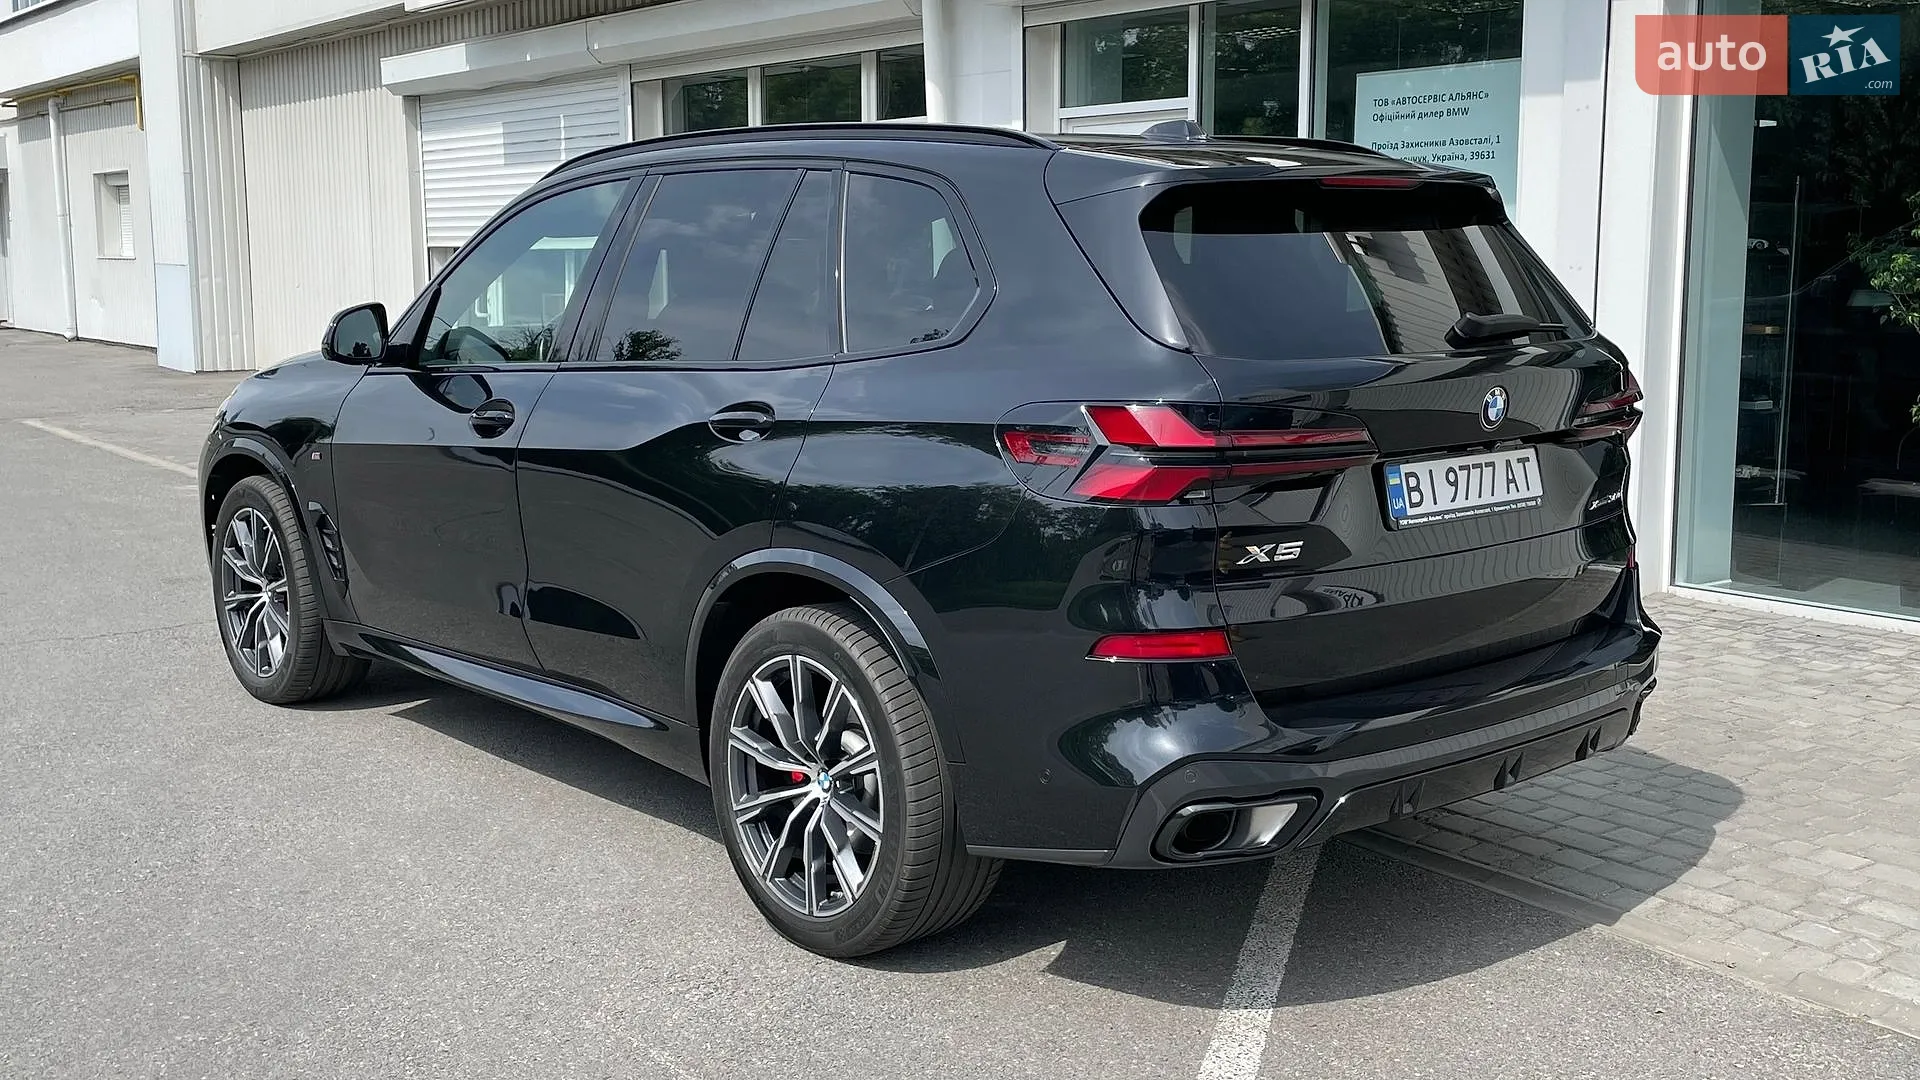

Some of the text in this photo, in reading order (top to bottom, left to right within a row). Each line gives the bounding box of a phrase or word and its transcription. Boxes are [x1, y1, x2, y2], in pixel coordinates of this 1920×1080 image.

[1373, 90, 1489, 107] ТОВ «АВТОСЕРВІС АЛЬЯНС»
[1372, 107, 1470, 123] Офіційний дилер BMW
[1371, 135, 1501, 151] Проїзд Захисників Азовсталі, 1
[1431, 152, 1468, 163] Україна,
[1469, 150, 1496, 160] 39631
[1404, 456, 1531, 508] BI 9777 AT
[1393, 498, 1405, 509] UA
[1236, 541, 1304, 564] X5
